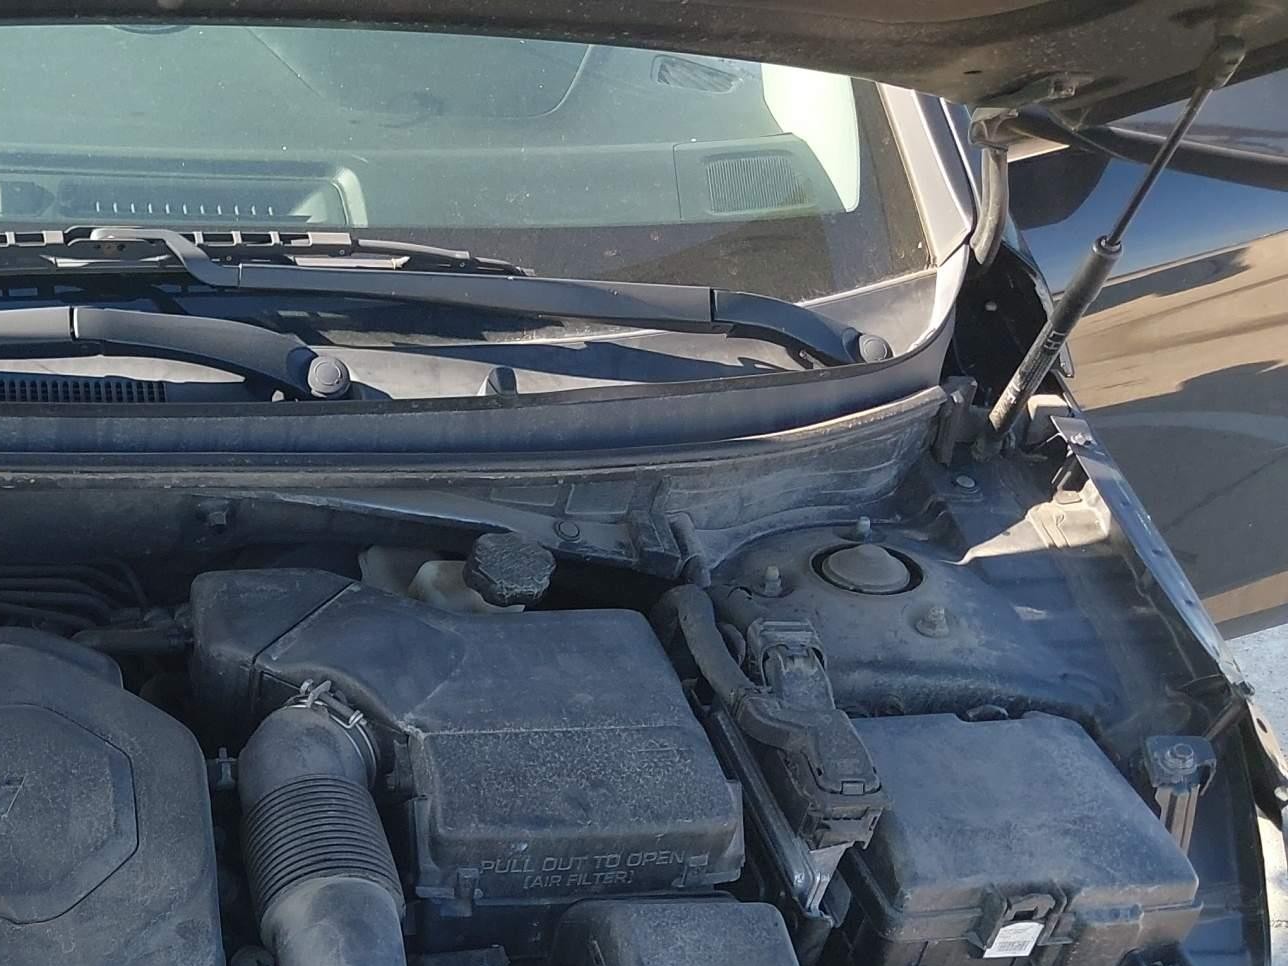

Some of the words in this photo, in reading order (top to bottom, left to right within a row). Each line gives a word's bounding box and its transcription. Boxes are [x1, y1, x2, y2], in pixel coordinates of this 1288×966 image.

[479, 858, 535, 874] PULL
[541, 855, 588, 872] OUT
[593, 854, 622, 869] TO
[626, 850, 687, 868] OPEN
